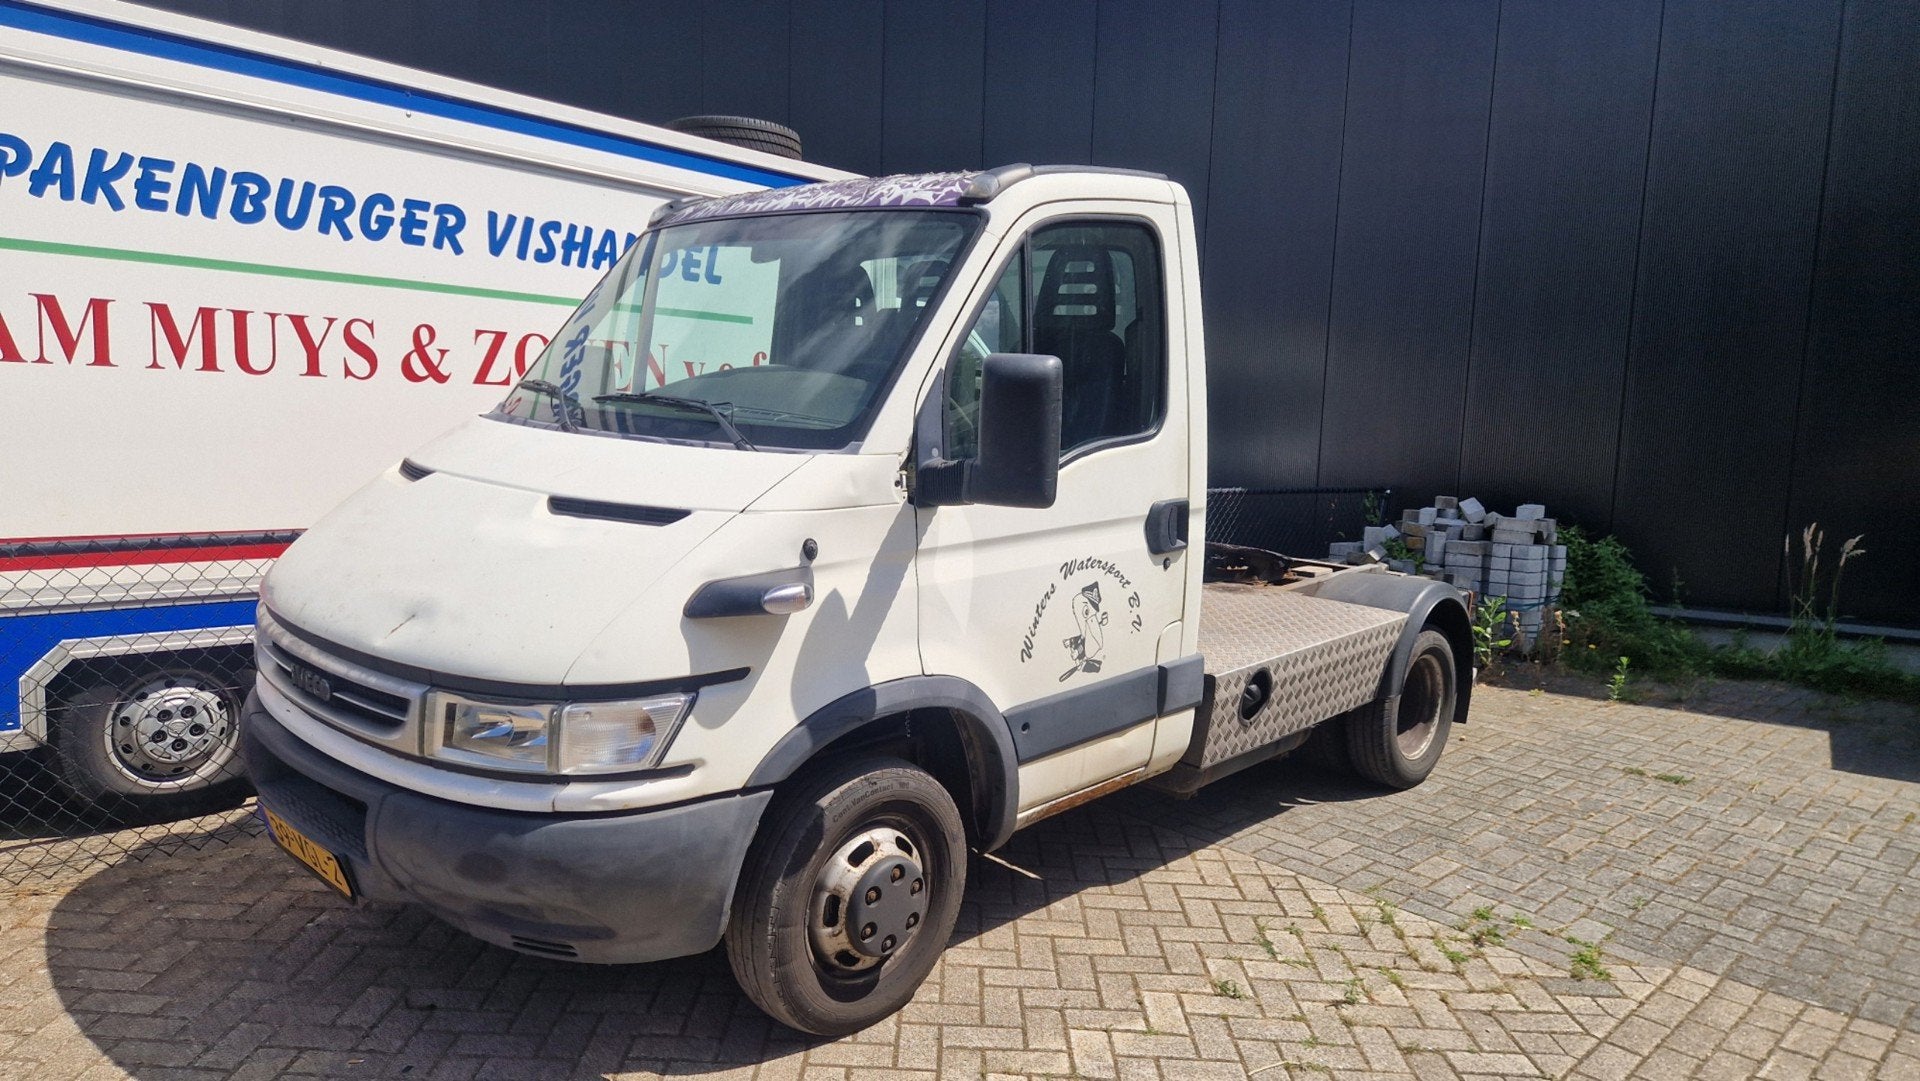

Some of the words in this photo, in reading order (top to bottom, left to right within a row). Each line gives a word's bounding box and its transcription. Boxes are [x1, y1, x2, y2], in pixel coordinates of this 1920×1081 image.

[0, 133, 467, 256] PAKENBURGER
[143, 302, 379, 381] MUYS
[400, 323, 452, 384] &
[1020, 583, 1056, 663] Winters
[1060, 556, 1131, 588] Watersport
